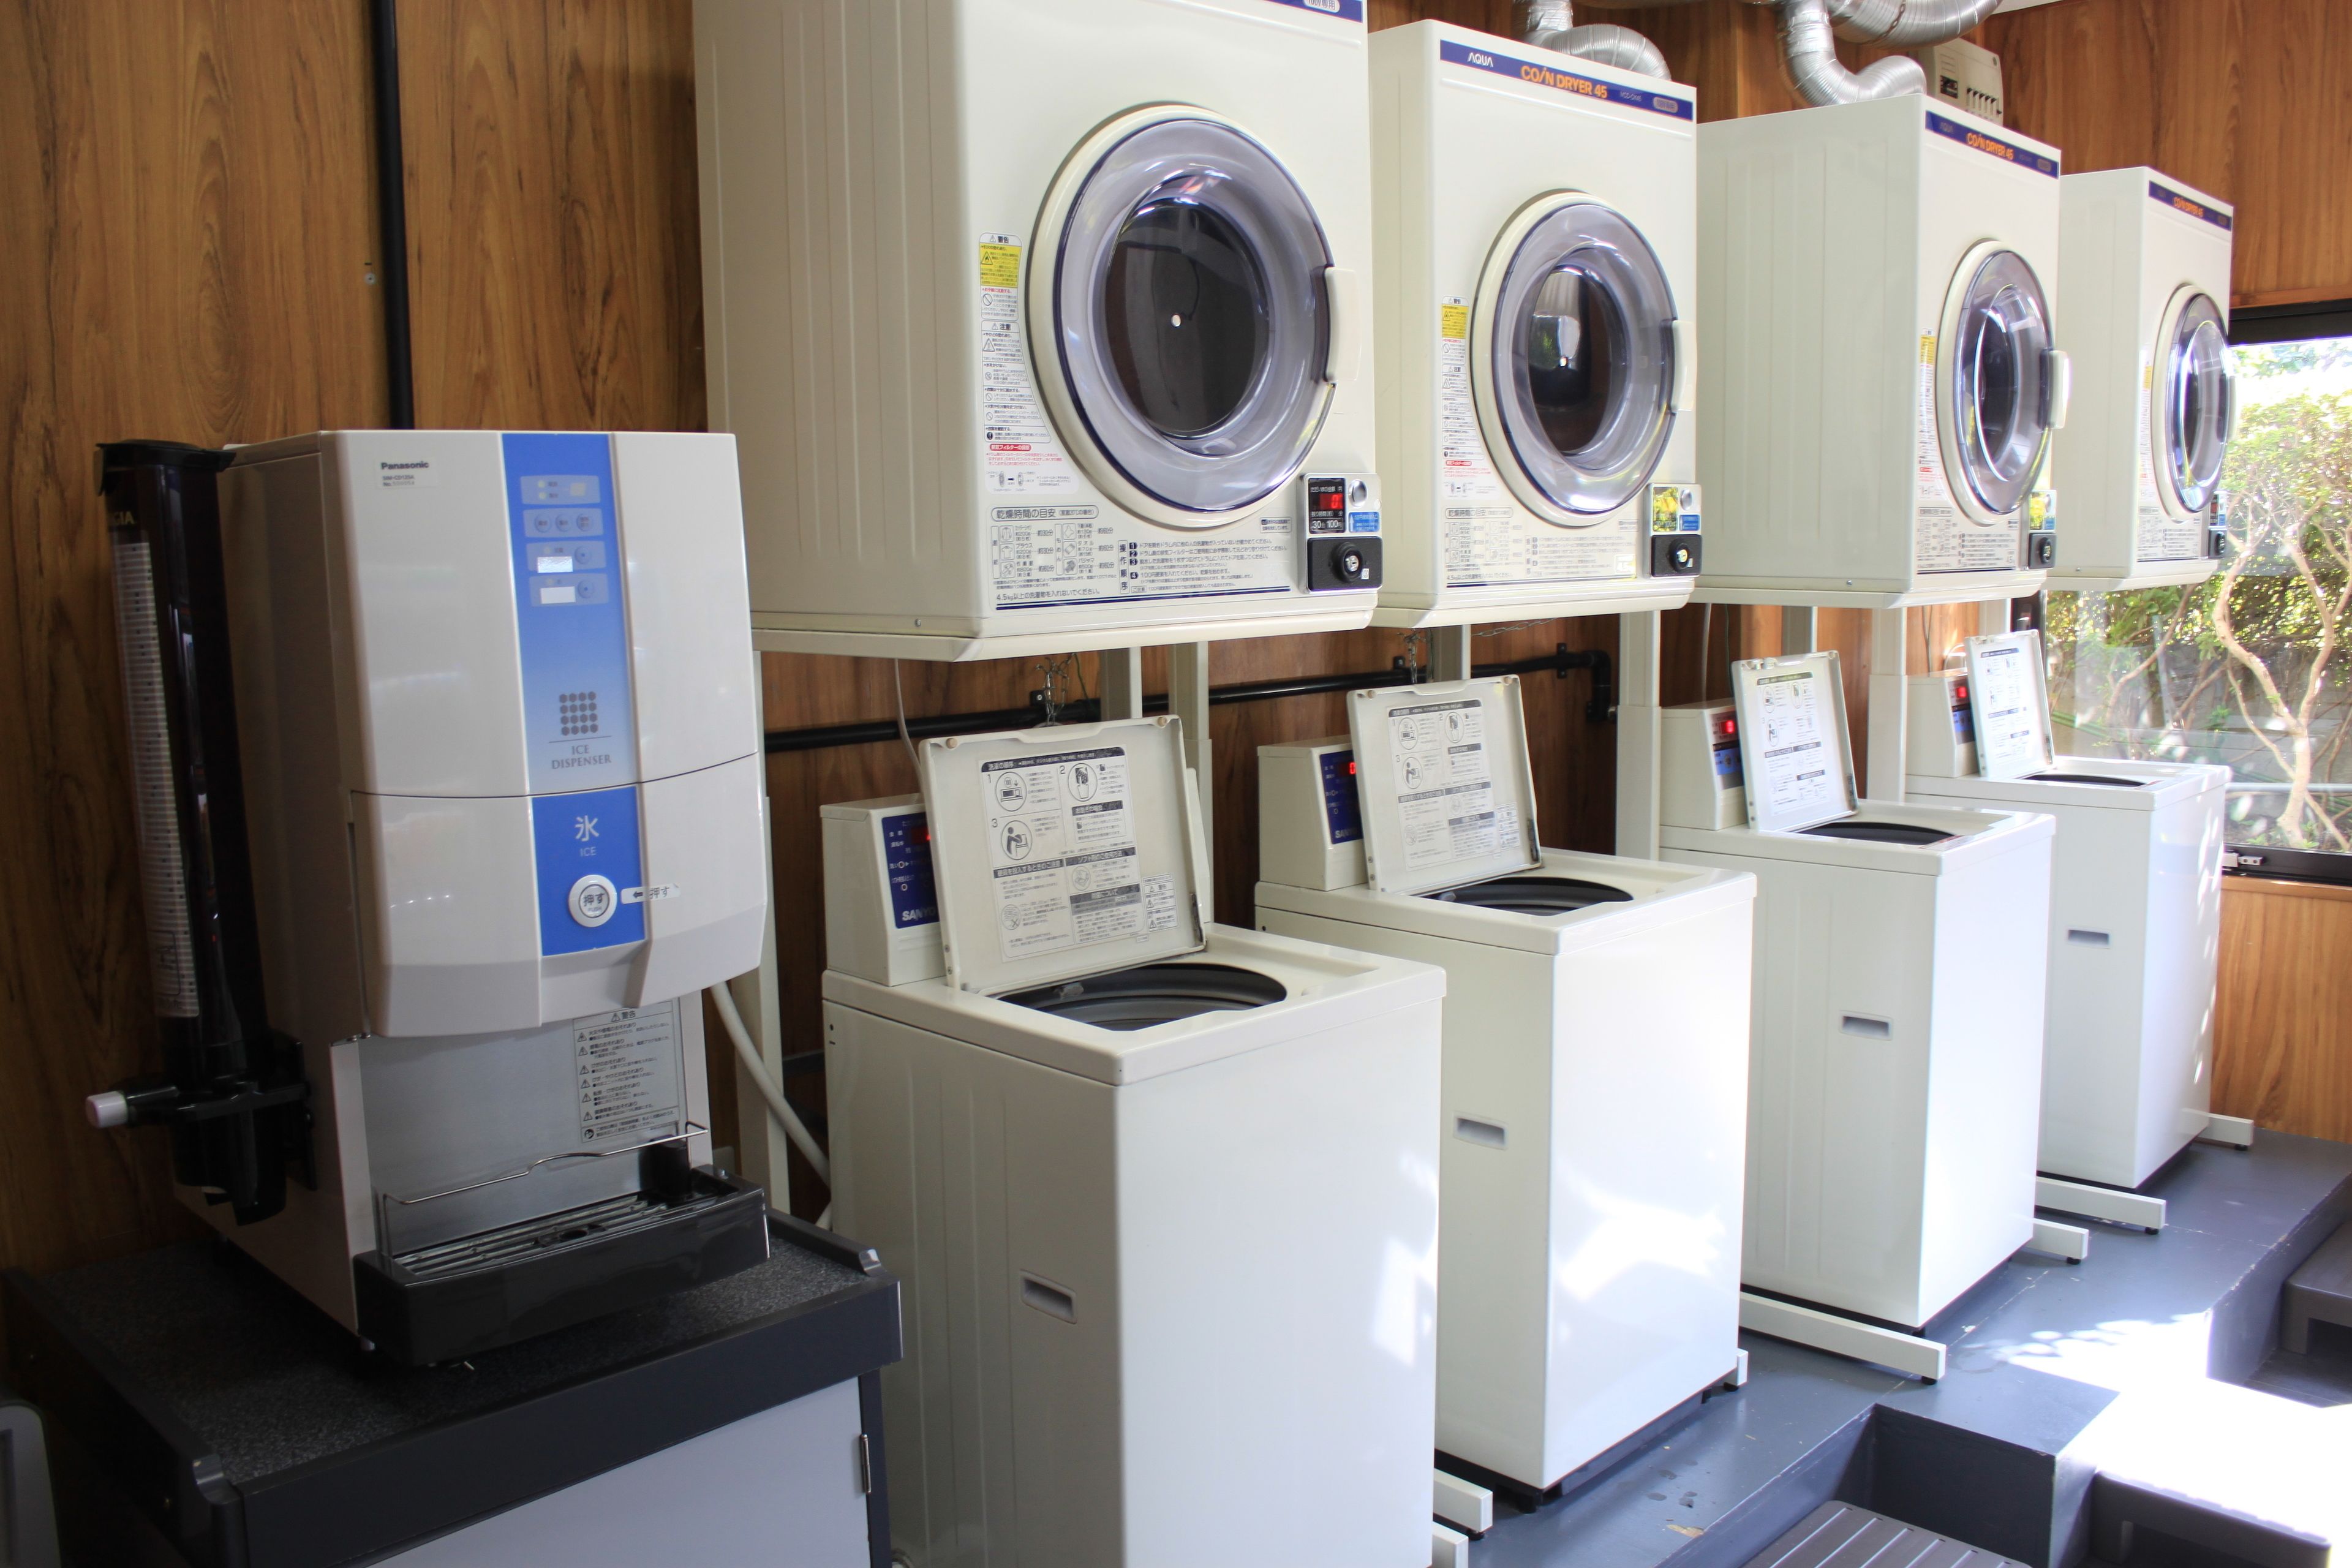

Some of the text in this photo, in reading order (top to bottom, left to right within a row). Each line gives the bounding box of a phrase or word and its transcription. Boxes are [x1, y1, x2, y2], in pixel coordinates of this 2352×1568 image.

[1467, 52, 1494, 68] AQUA
[1520, 65, 1608, 99] COIN DRYER 45
[1966, 132, 1986, 150] COIN
[1986, 139, 2006, 157] DRYER
[381, 461, 429, 470] Panasonic
[997, 508, 1057, 519] 乾燥時間の目安
[571, 744, 590, 755] ICE
[551, 754, 612, 769] DISPENSER
[1060, 765, 1065, 775] 2
[987, 774, 992, 783] 1
[575, 815, 600, 842] 氷
[991, 818, 998, 828] 3
[579, 846, 597, 857] ICE
[649, 886, 670, 900] 押す
[582, 892, 605, 907] 押す
[902, 905, 937, 921] SANYO
[622, 1010, 636, 1020] 警告
